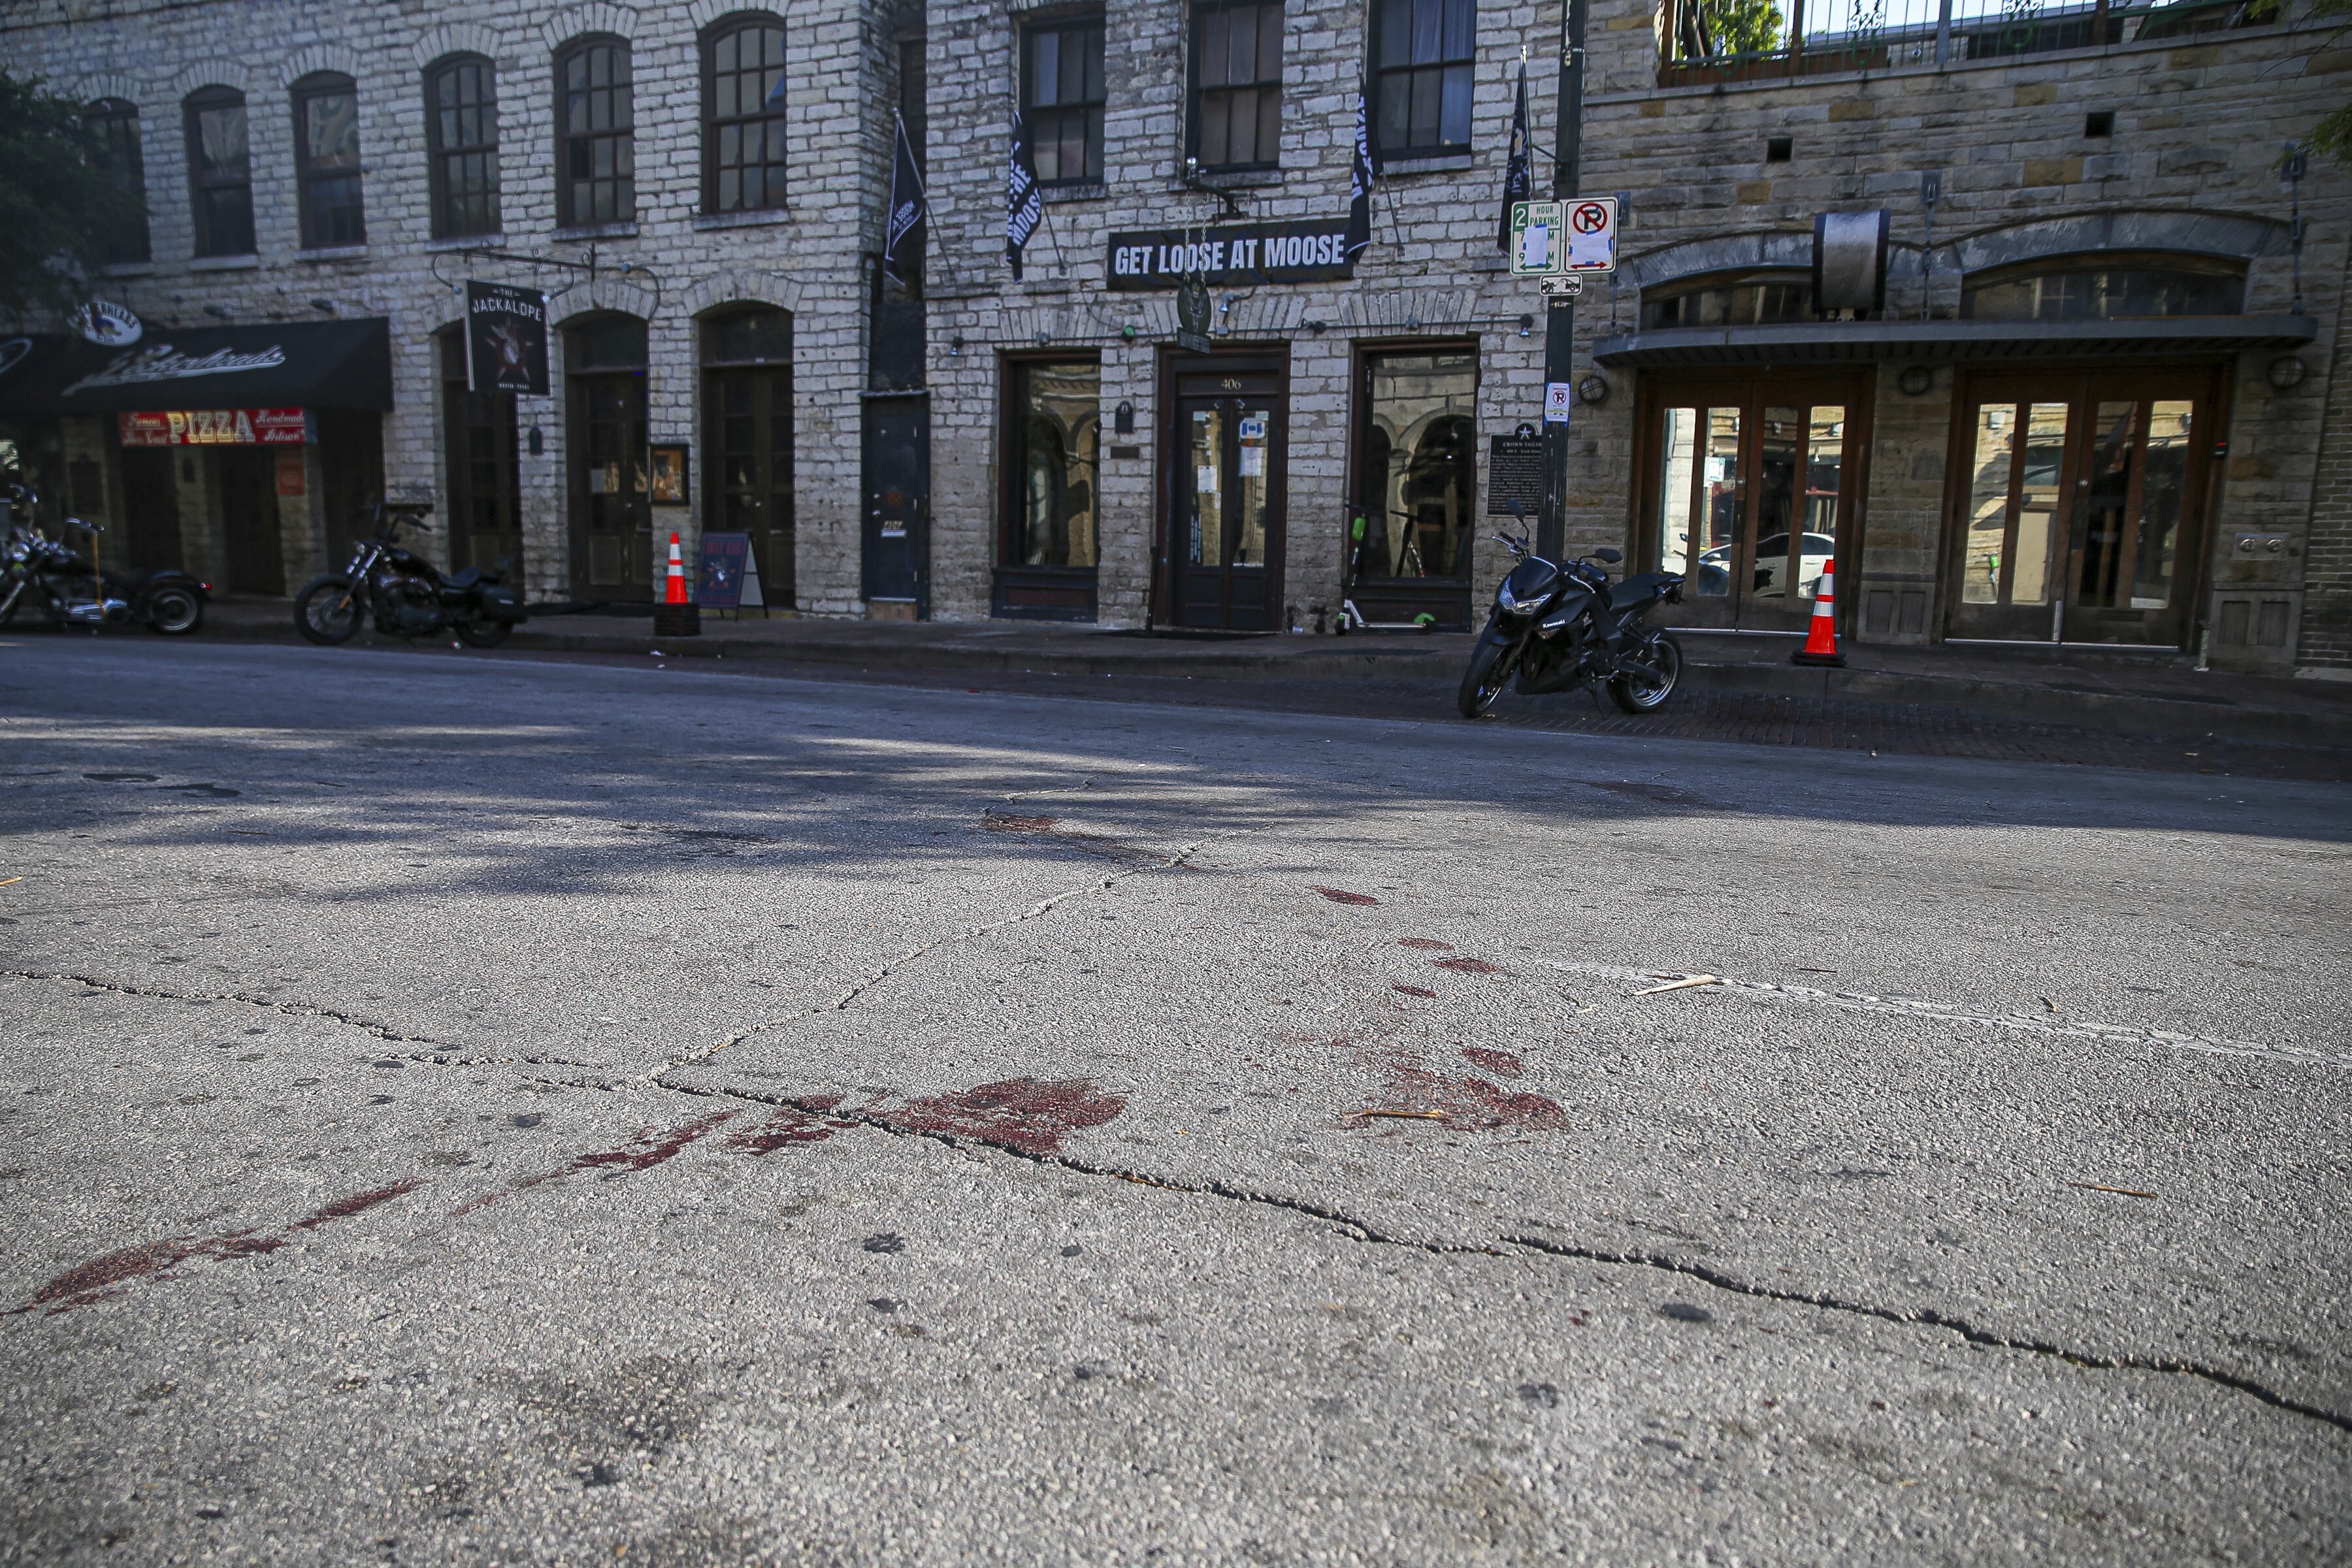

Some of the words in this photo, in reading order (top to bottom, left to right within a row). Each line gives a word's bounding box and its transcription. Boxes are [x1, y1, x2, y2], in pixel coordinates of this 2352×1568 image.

[1537, 205, 1554, 214] HOUR
[1515, 207, 1527, 227] 2
[1529, 216, 1560, 226] PARKING
[1115, 246, 1153, 275] GET
[1158, 241, 1225, 274] LOOSE
[1230, 237, 1258, 270] AT
[1265, 233, 1346, 269] MOOSE
[499, 287, 514, 298] THE
[472, 297, 543, 322] JACKALOPE
[1221, 378, 1242, 390] 406
[167, 410, 255, 444] PIZZA
[1543, 618, 1565, 629] Kawasaki
